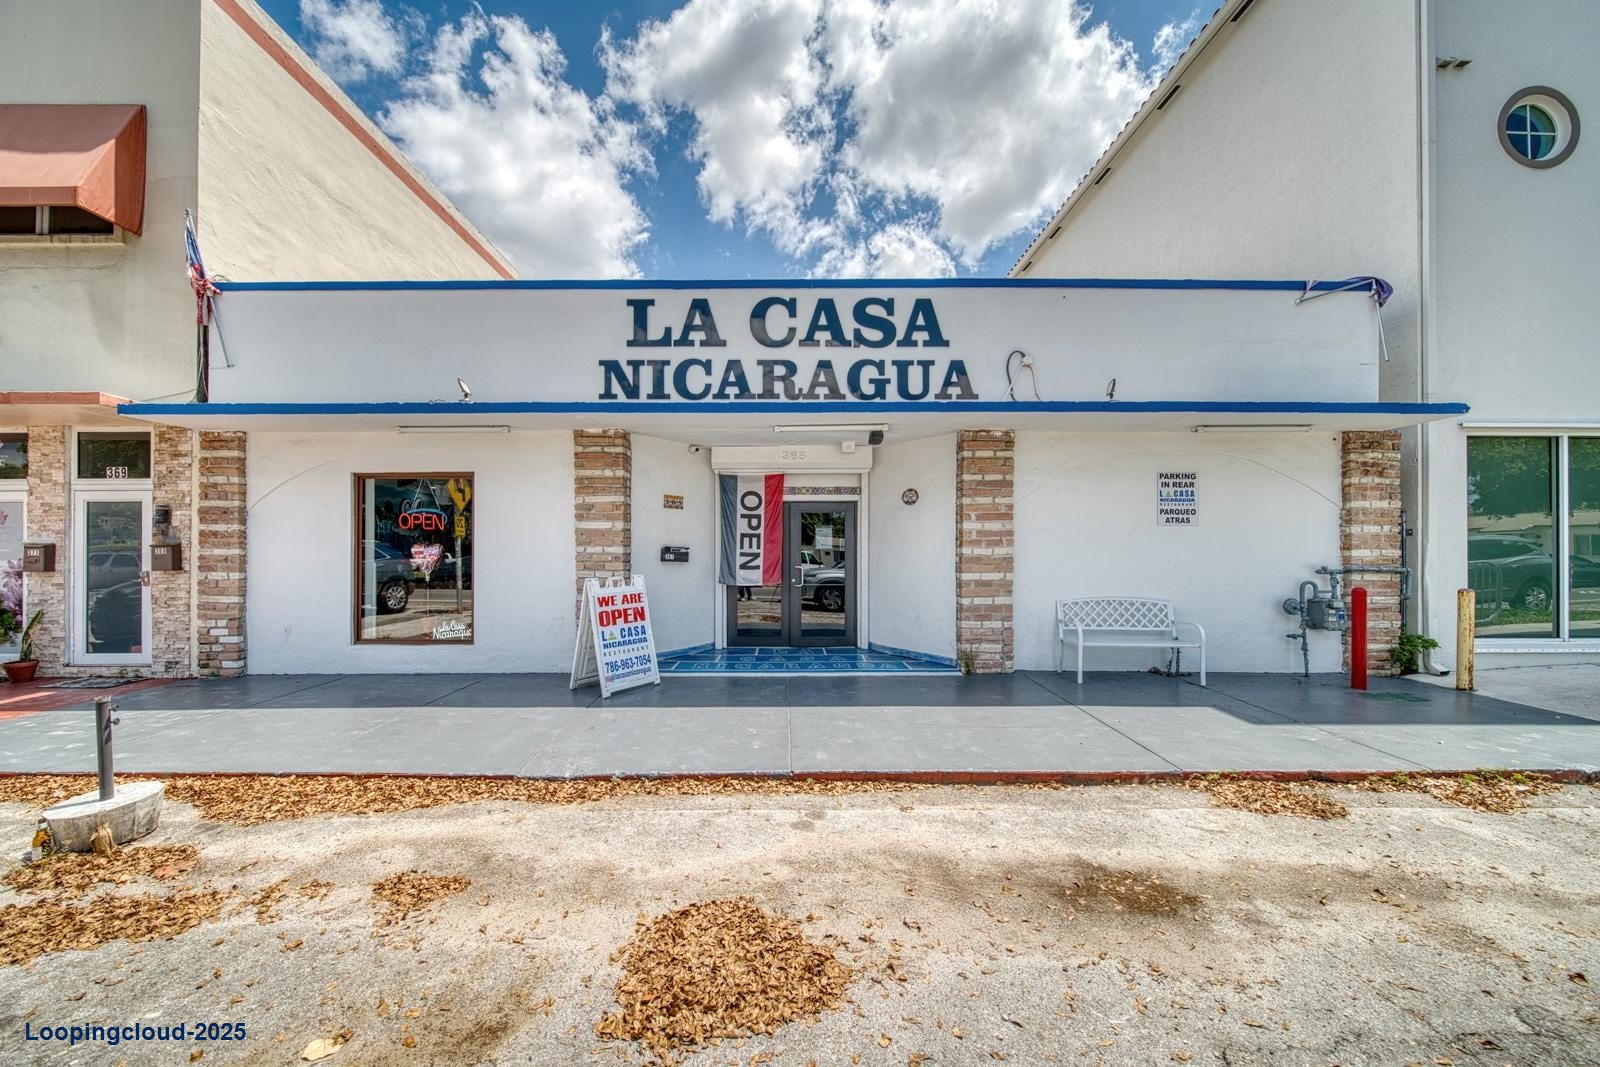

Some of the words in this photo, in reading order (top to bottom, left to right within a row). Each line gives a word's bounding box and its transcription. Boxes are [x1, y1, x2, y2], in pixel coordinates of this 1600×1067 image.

[626, 298, 727, 348] LA
[749, 296, 950, 349] CASA
[598, 358, 979, 400] NICARAGUA
[782, 450, 807, 460] 365
[107, 467, 127, 478] 369
[1173, 489, 1195, 497] CASA
[1159, 508, 1197, 516] PARQUEO
[398, 512, 446, 531] OPEN
[739, 490, 763, 570] OPEN
[596, 595, 618, 608] WE
[621, 592, 644, 605] ARE
[598, 606, 646, 628] OPEN
[620, 625, 647, 639] CASA
[603, 636, 648, 650] NICARAGUA
[603, 645, 649, 657] RESTAURANT
[604, 654, 652, 673] 786-963-7054
